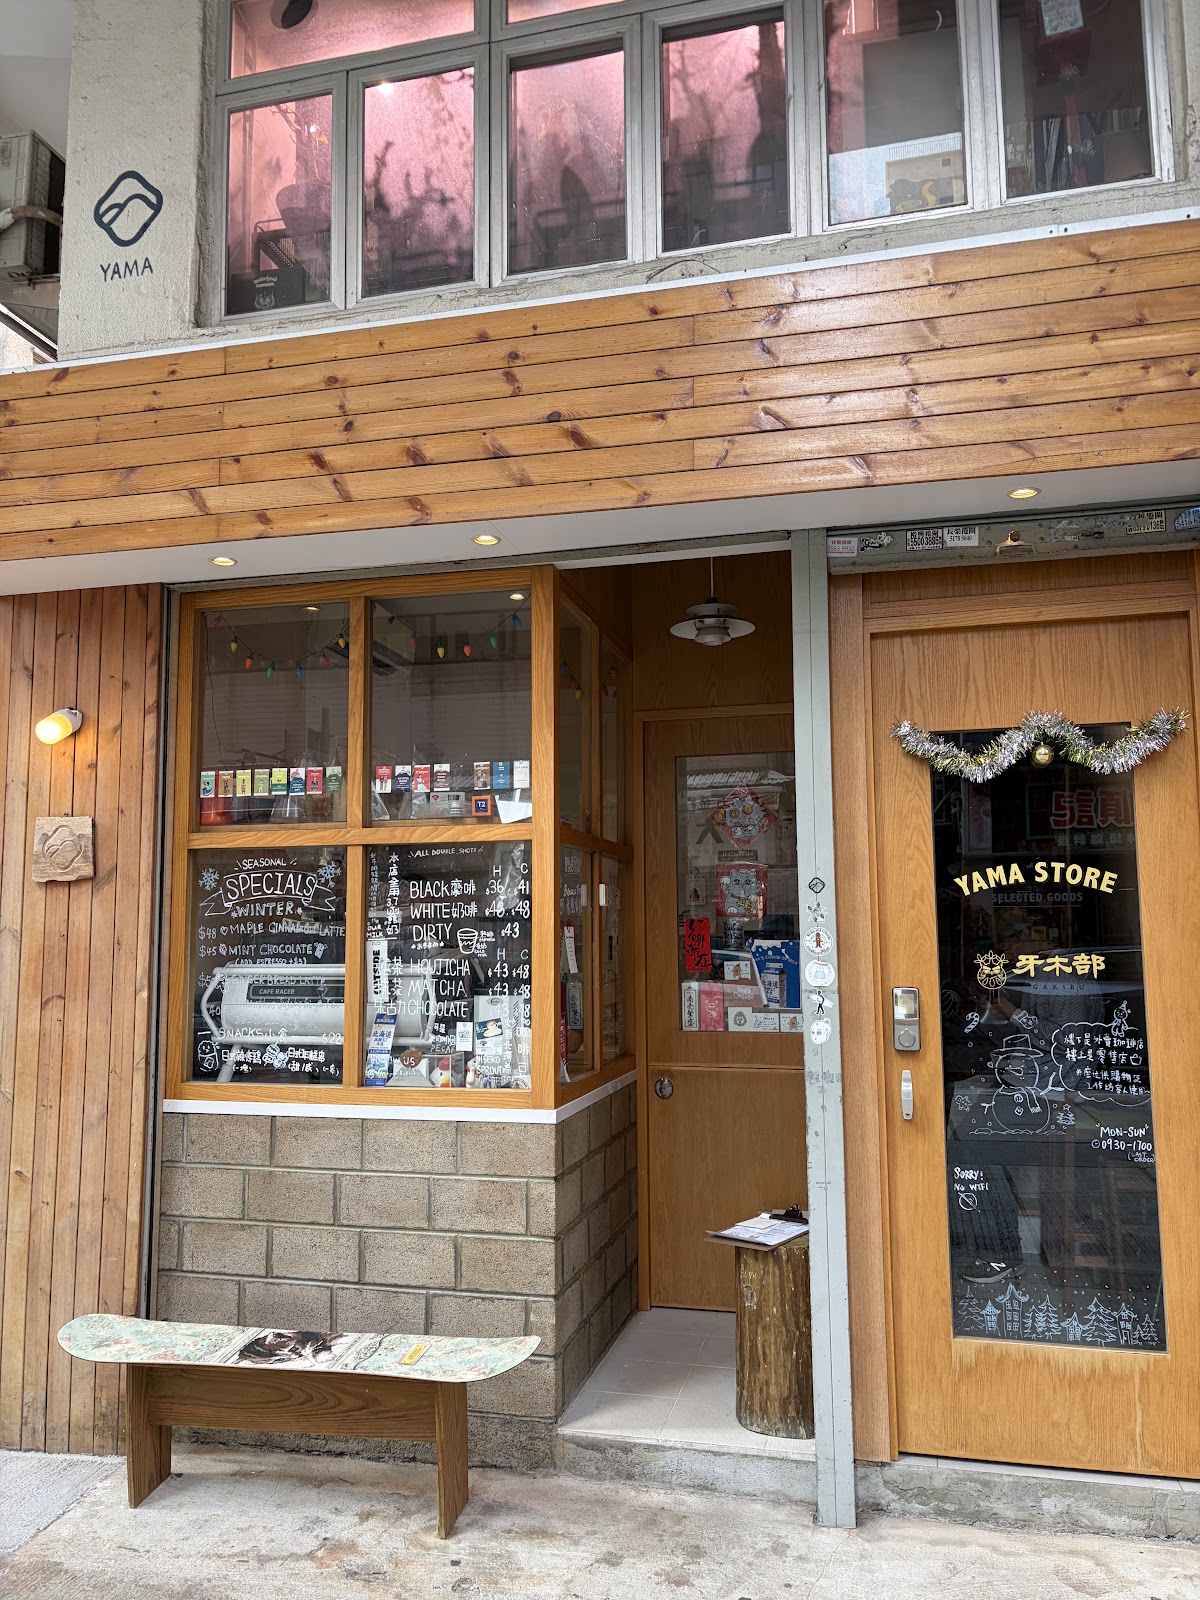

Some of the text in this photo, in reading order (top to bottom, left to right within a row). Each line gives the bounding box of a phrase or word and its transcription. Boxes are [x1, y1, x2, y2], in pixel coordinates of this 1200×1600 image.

[99, 256, 153, 282] YAMA
[414, 847, 477, 858] ALL DOUBLE SHOTS
[242, 857, 287, 870] SEASONAL
[492, 862, 529, 877] H C
[226, 872, 316, 900] SPECIALS
[953, 861, 1119, 897] YAMA STORE
[409, 880, 451, 899] BLACK
[485, 879, 506, 896] $36
[513, 879, 530, 896] $41
[992, 891, 1084, 903] SELECTED GOODS
[236, 901, 295, 917] WINTER
[410, 902, 451, 919] WHITE
[511, 900, 531, 919] $48
[198, 925, 217, 940] $48
[229, 922, 265, 936] MAPLE
[319, 924, 345, 938] LATTE
[412, 921, 520, 941] DIRTY $43
[198, 943, 313, 958] $45 MINT CHOCOLATE
[496, 947, 529, 960] H C
[410, 958, 471, 977] HOUJICHA
[488, 961, 509, 978] $43
[512, 964, 530, 979] $48
[1012, 953, 1106, 979] 牙木部
[407, 979, 468, 998] MATCHA
[488, 981, 509, 998] $43
[513, 984, 531, 999] $48
[407, 999, 469, 1017] CHOCOLATE
[217, 1027, 264, 1040] SNACKS
[321, 1032, 342, 1045] $22
[403, 1056, 416, 1066] US
[1101, 1138, 1153, 1151] 0930-1700
